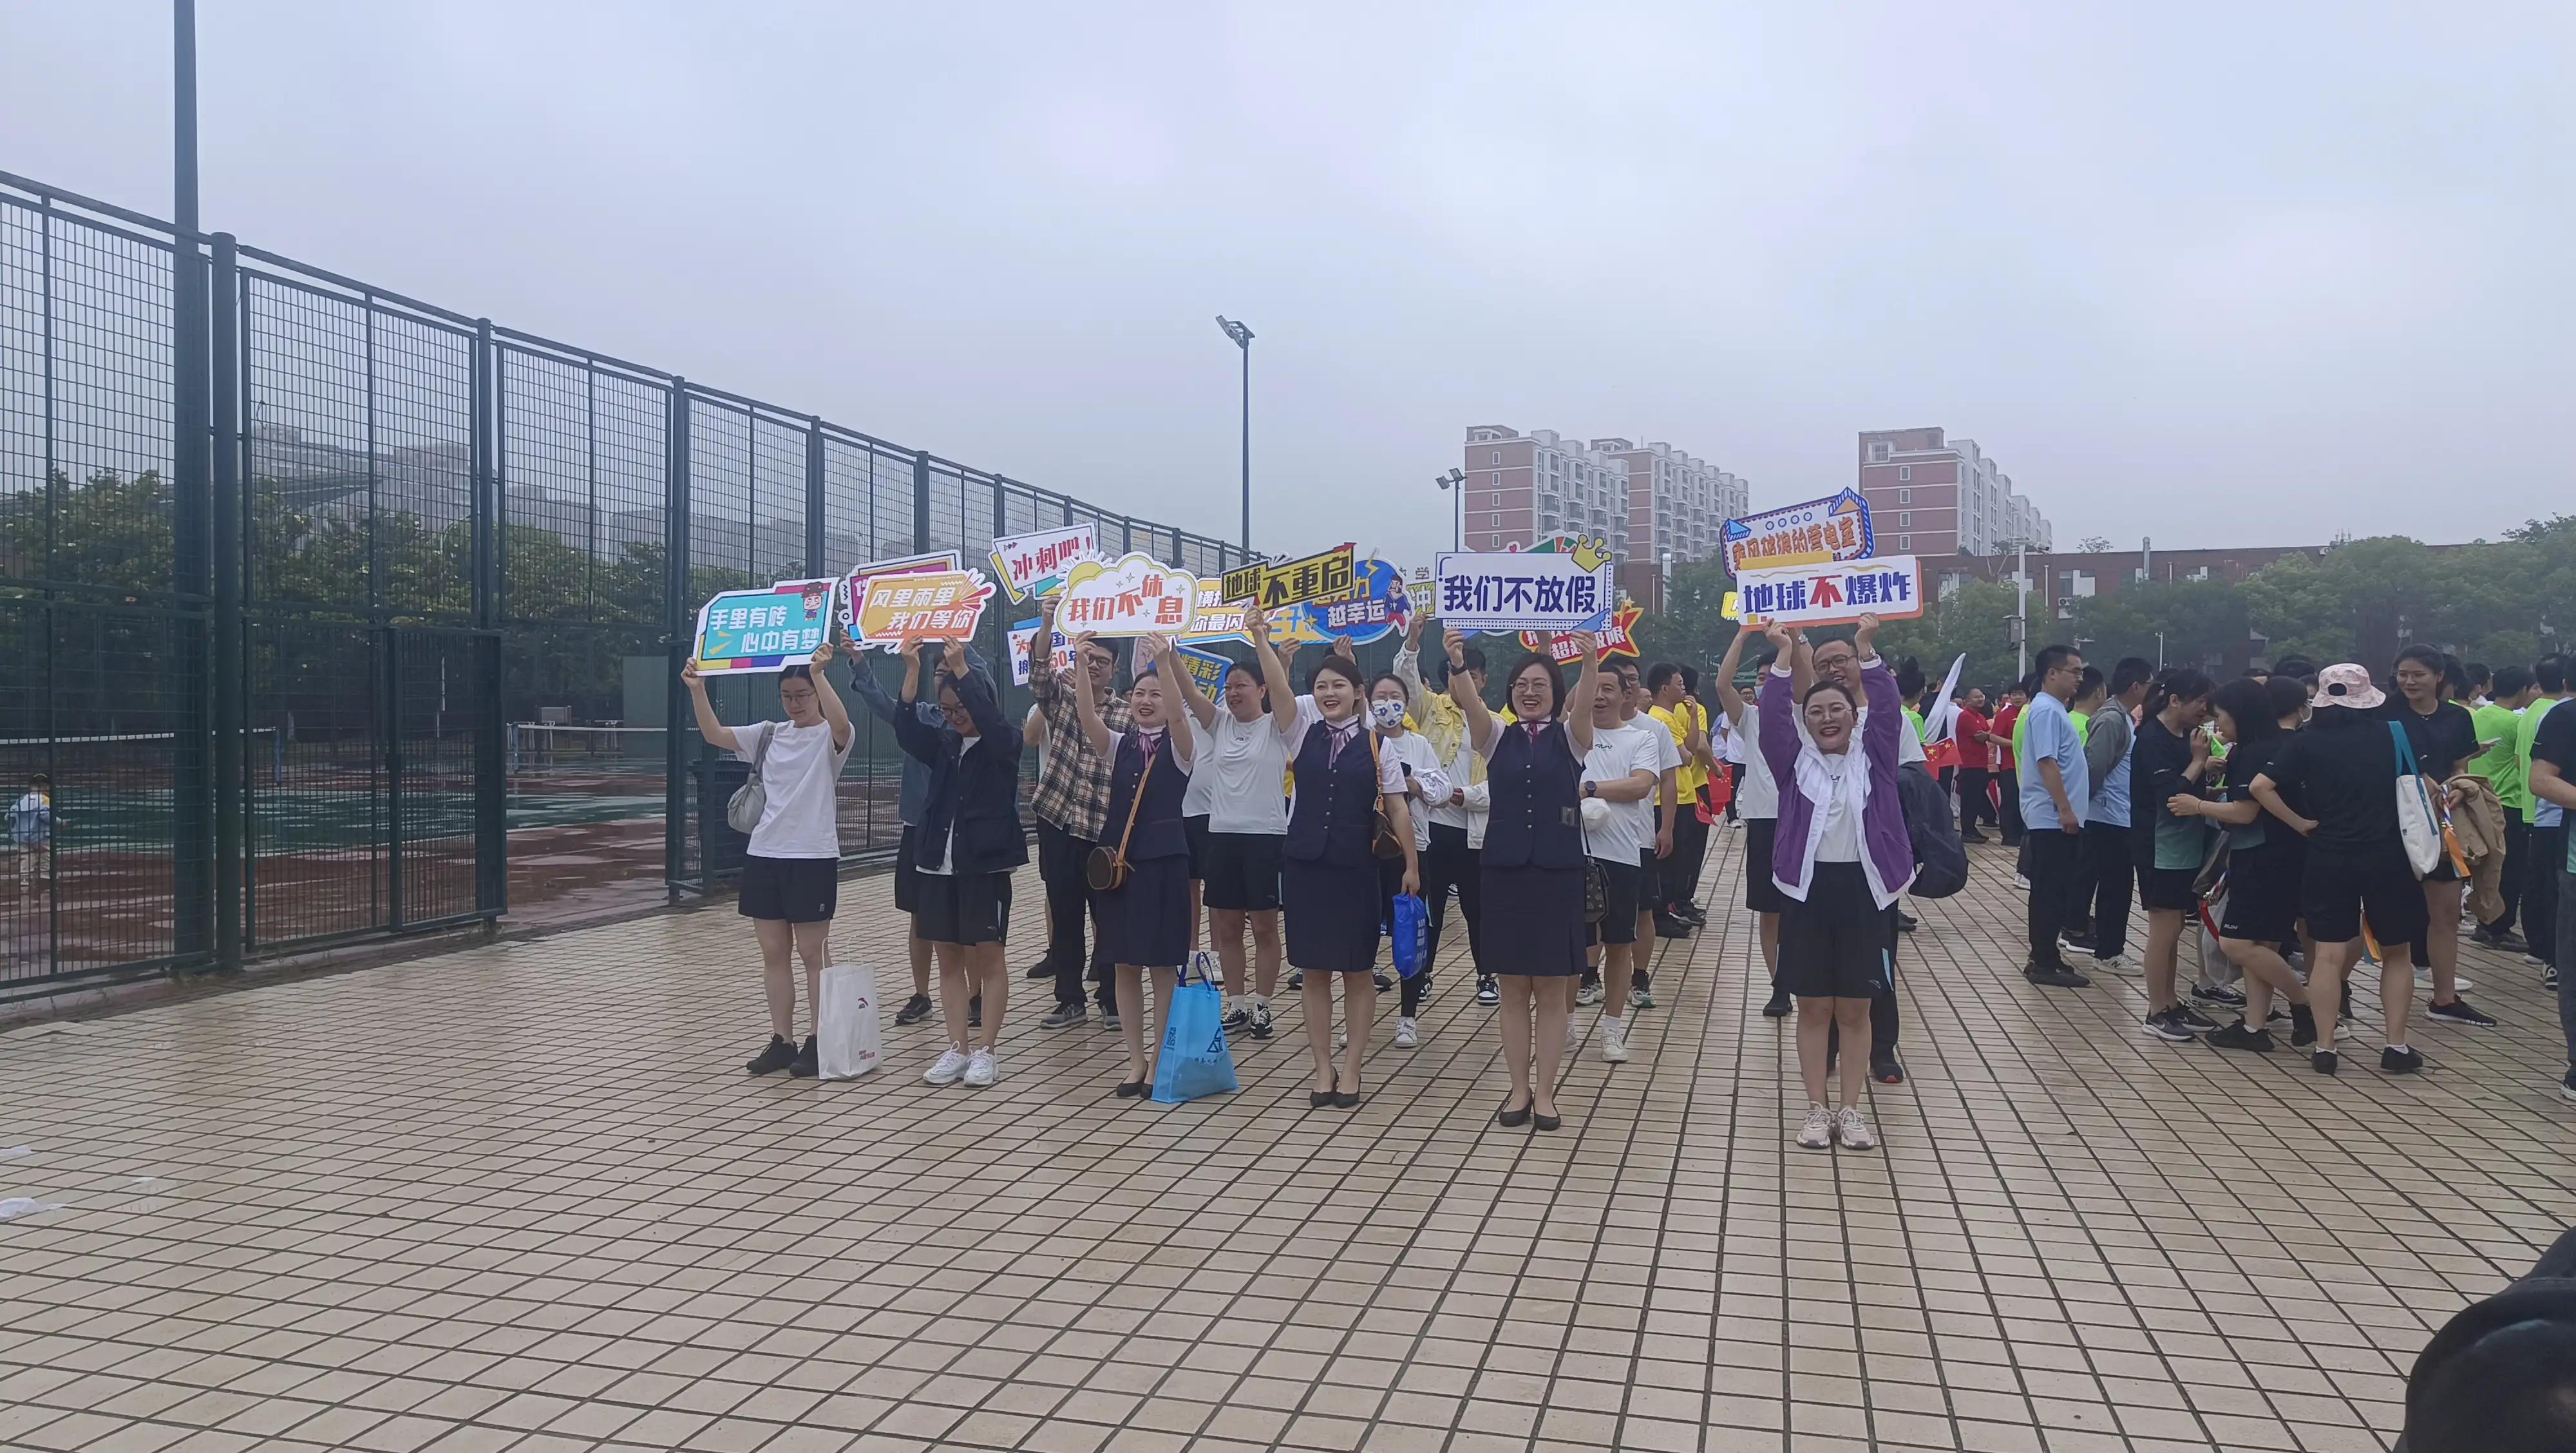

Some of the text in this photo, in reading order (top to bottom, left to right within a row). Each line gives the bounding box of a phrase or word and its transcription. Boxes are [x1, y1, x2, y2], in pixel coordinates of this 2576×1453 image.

[1226, 556, 1349, 607] 地球不重启
[1443, 575, 1596, 613] 我们不放假
[1743, 571, 1911, 614] 地球不爆炸
[869, 587, 956, 609] 风里雨里
[1068, 574, 1184, 625] 我们不休息
[710, 605, 788, 631] 手里有砖
[886, 609, 975, 631] 我们等你
[1190, 613, 1249, 632] 你最闪
[1327, 599, 1385, 629] 越幸运
[740, 627, 820, 654] 心中有梦
